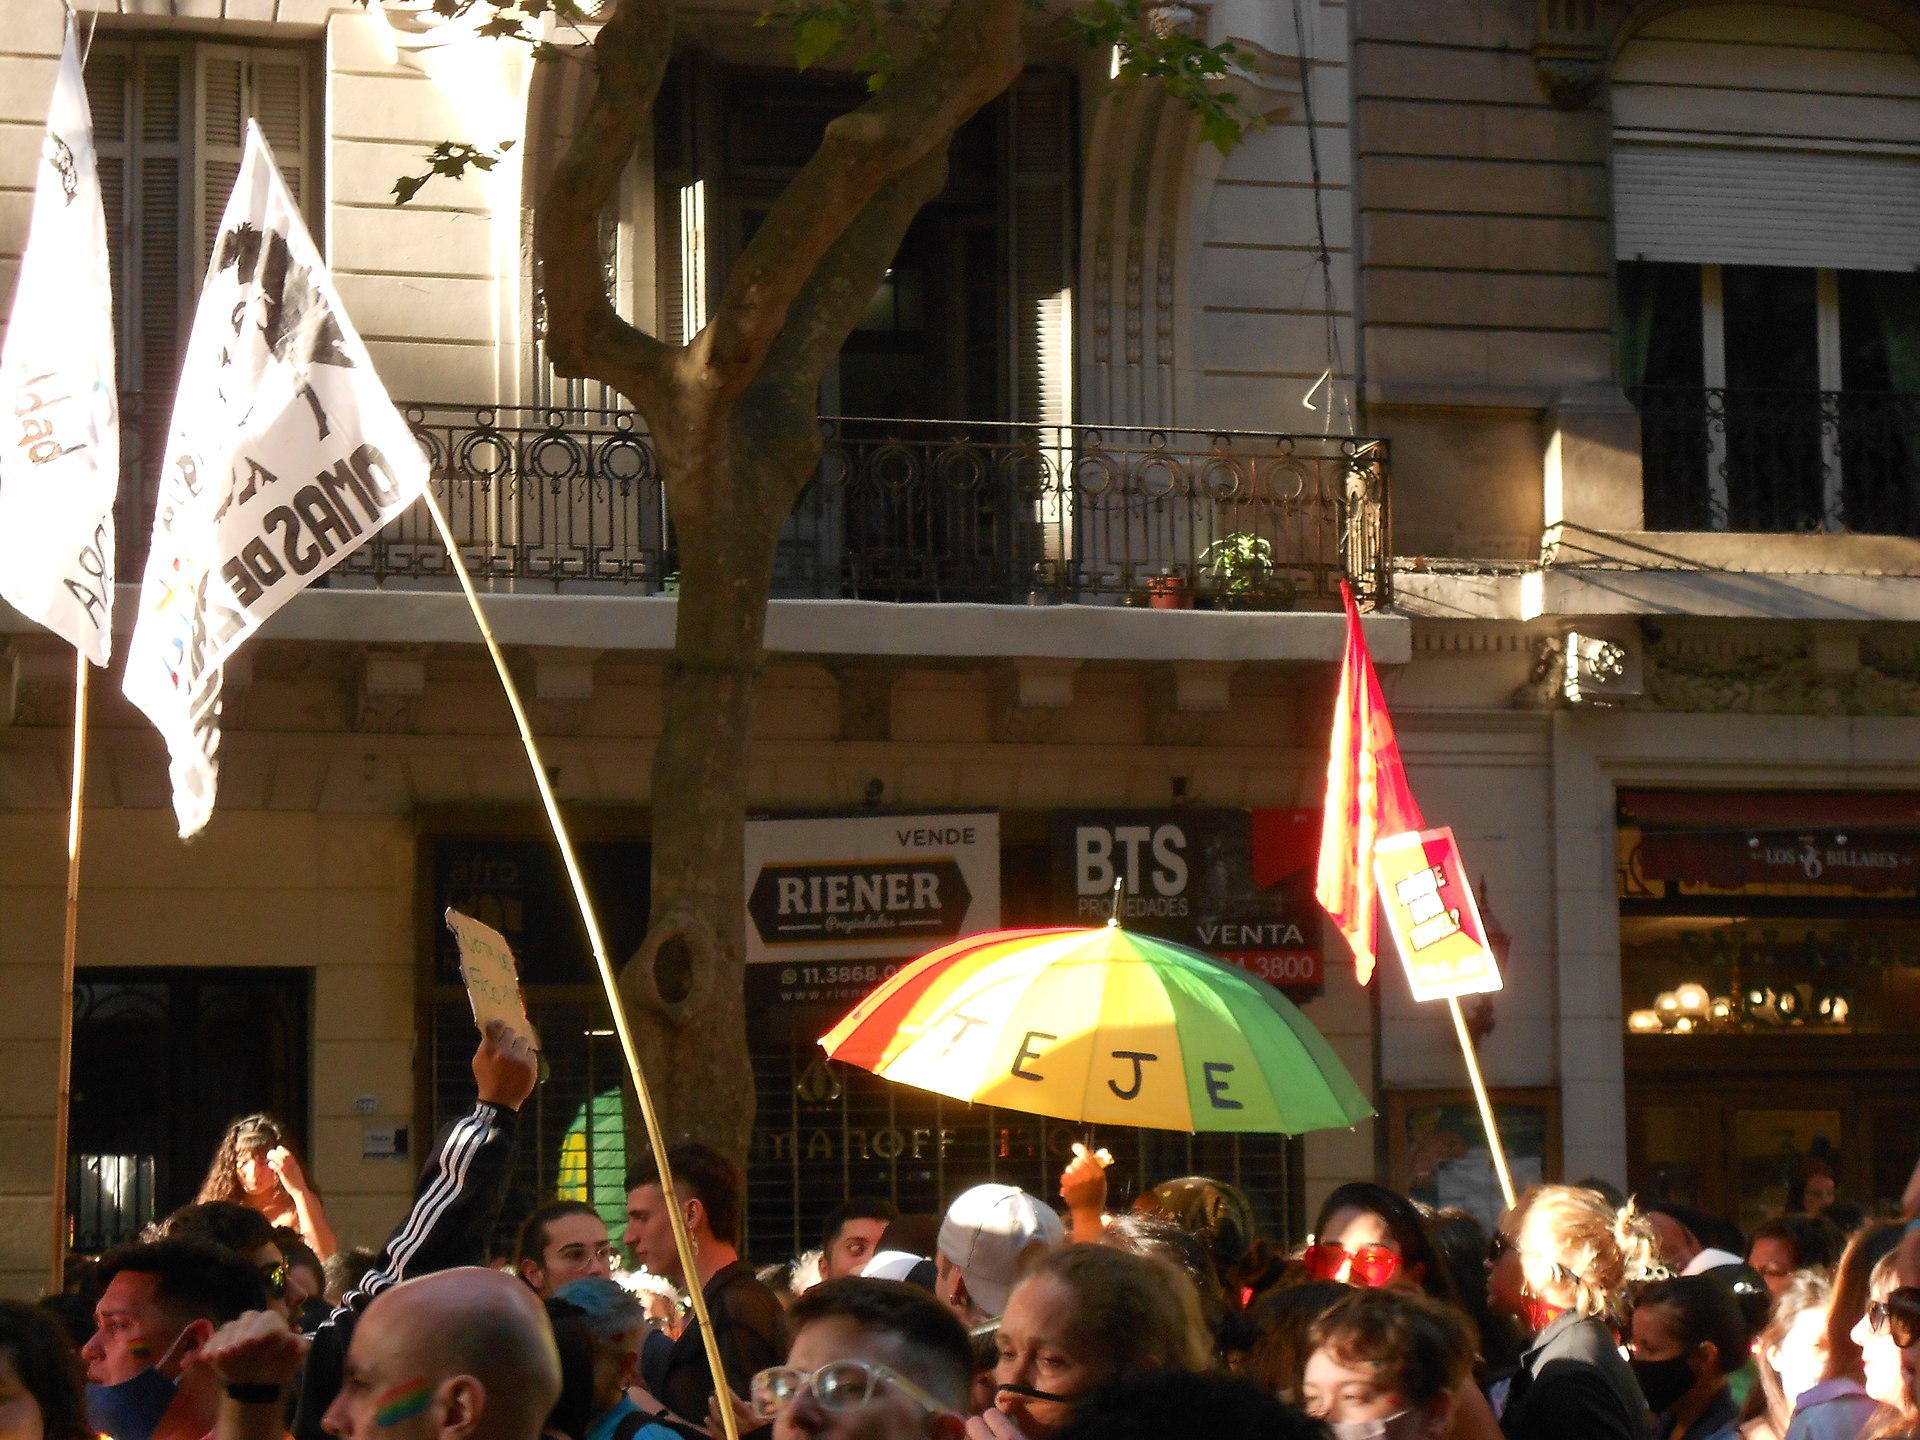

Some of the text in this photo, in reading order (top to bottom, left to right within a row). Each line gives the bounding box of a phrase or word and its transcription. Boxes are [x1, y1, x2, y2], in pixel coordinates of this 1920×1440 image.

[896, 828, 976, 846] VENDE
[1076, 823, 1188, 895] BTS
[1766, 848, 1796, 864] LOS
[1826, 850, 1898, 868] BILLARES
[777, 872, 942, 915] RIENER
[1078, 898, 1188, 917] PROEDADES
[1197, 923, 1304, 945] VENTA
[802, 964, 897, 986] 11.3868.0
